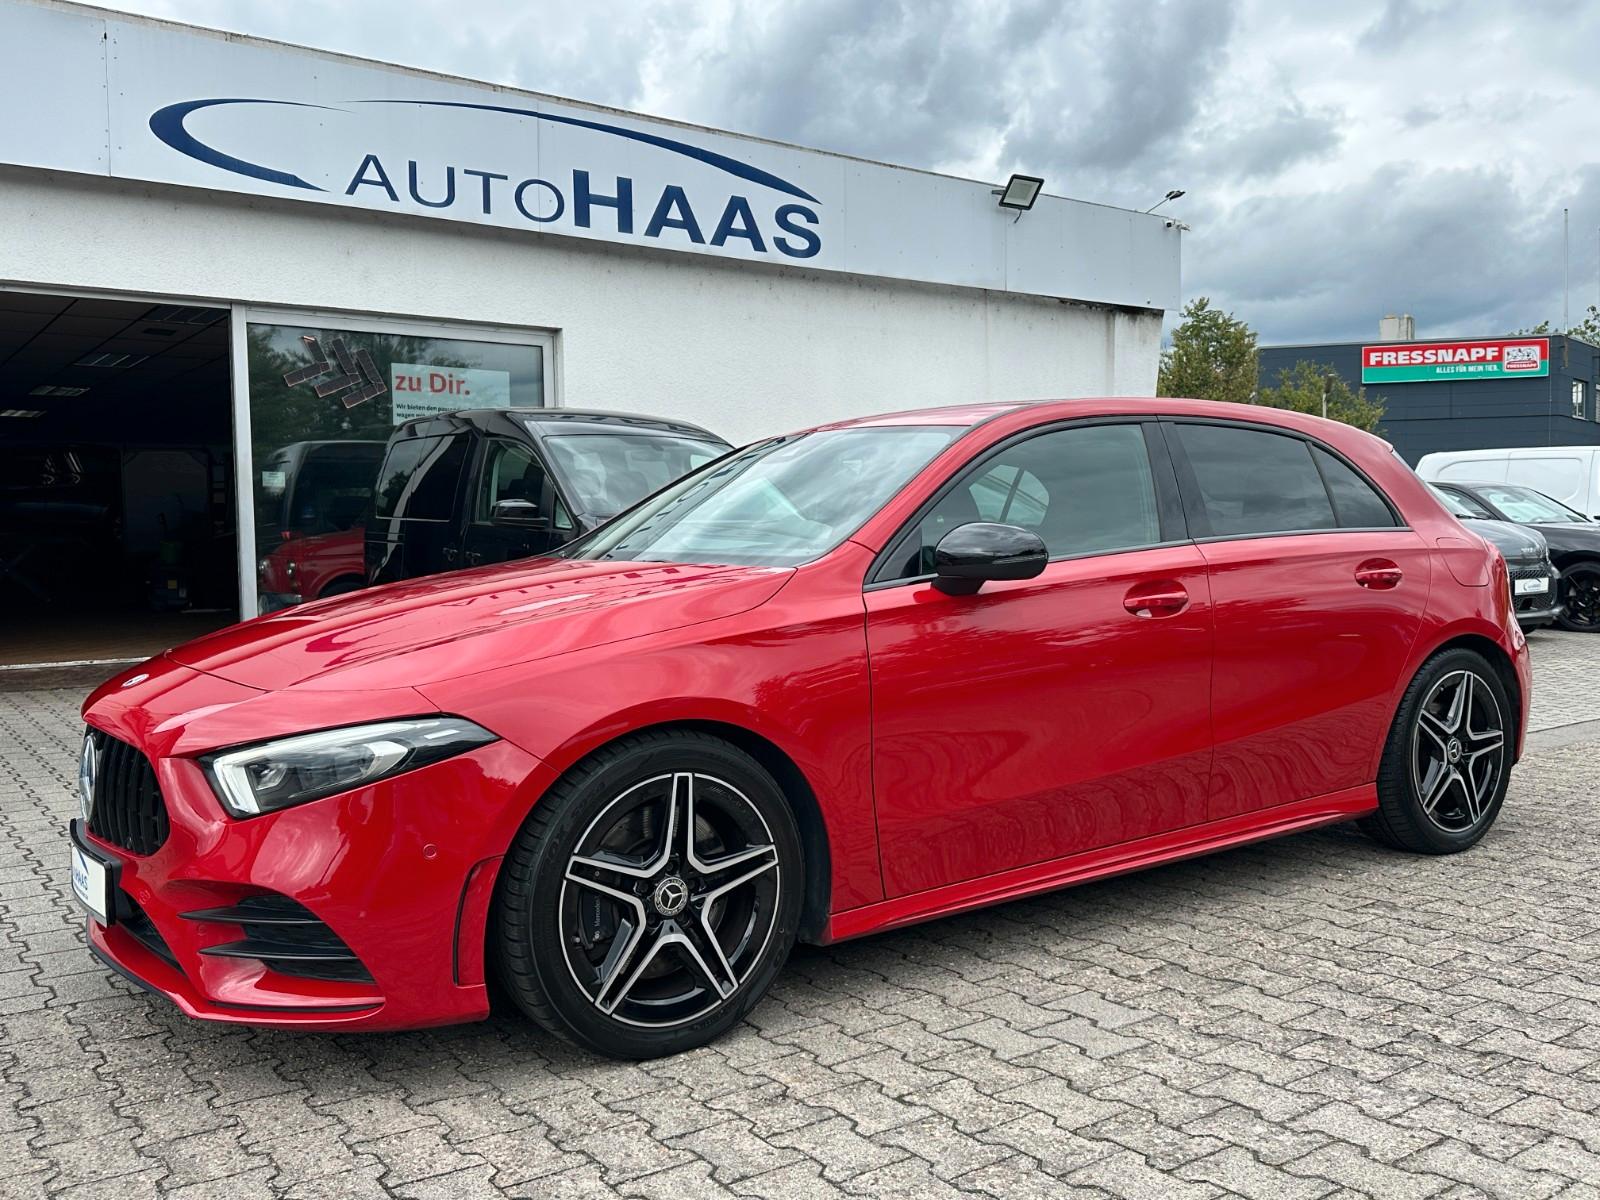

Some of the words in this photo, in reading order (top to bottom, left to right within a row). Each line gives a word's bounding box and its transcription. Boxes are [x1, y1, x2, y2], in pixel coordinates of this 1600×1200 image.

[1369, 347, 1500, 366] FRESSNAPF
[1436, 366, 1455, 374] ALLES
[1456, 364, 1467, 373] FÜR
[1468, 365, 1484, 373] MEIN
[1485, 364, 1499, 372] TIER.
[395, 375, 422, 392] zu
[429, 373, 470, 395] Dir.
